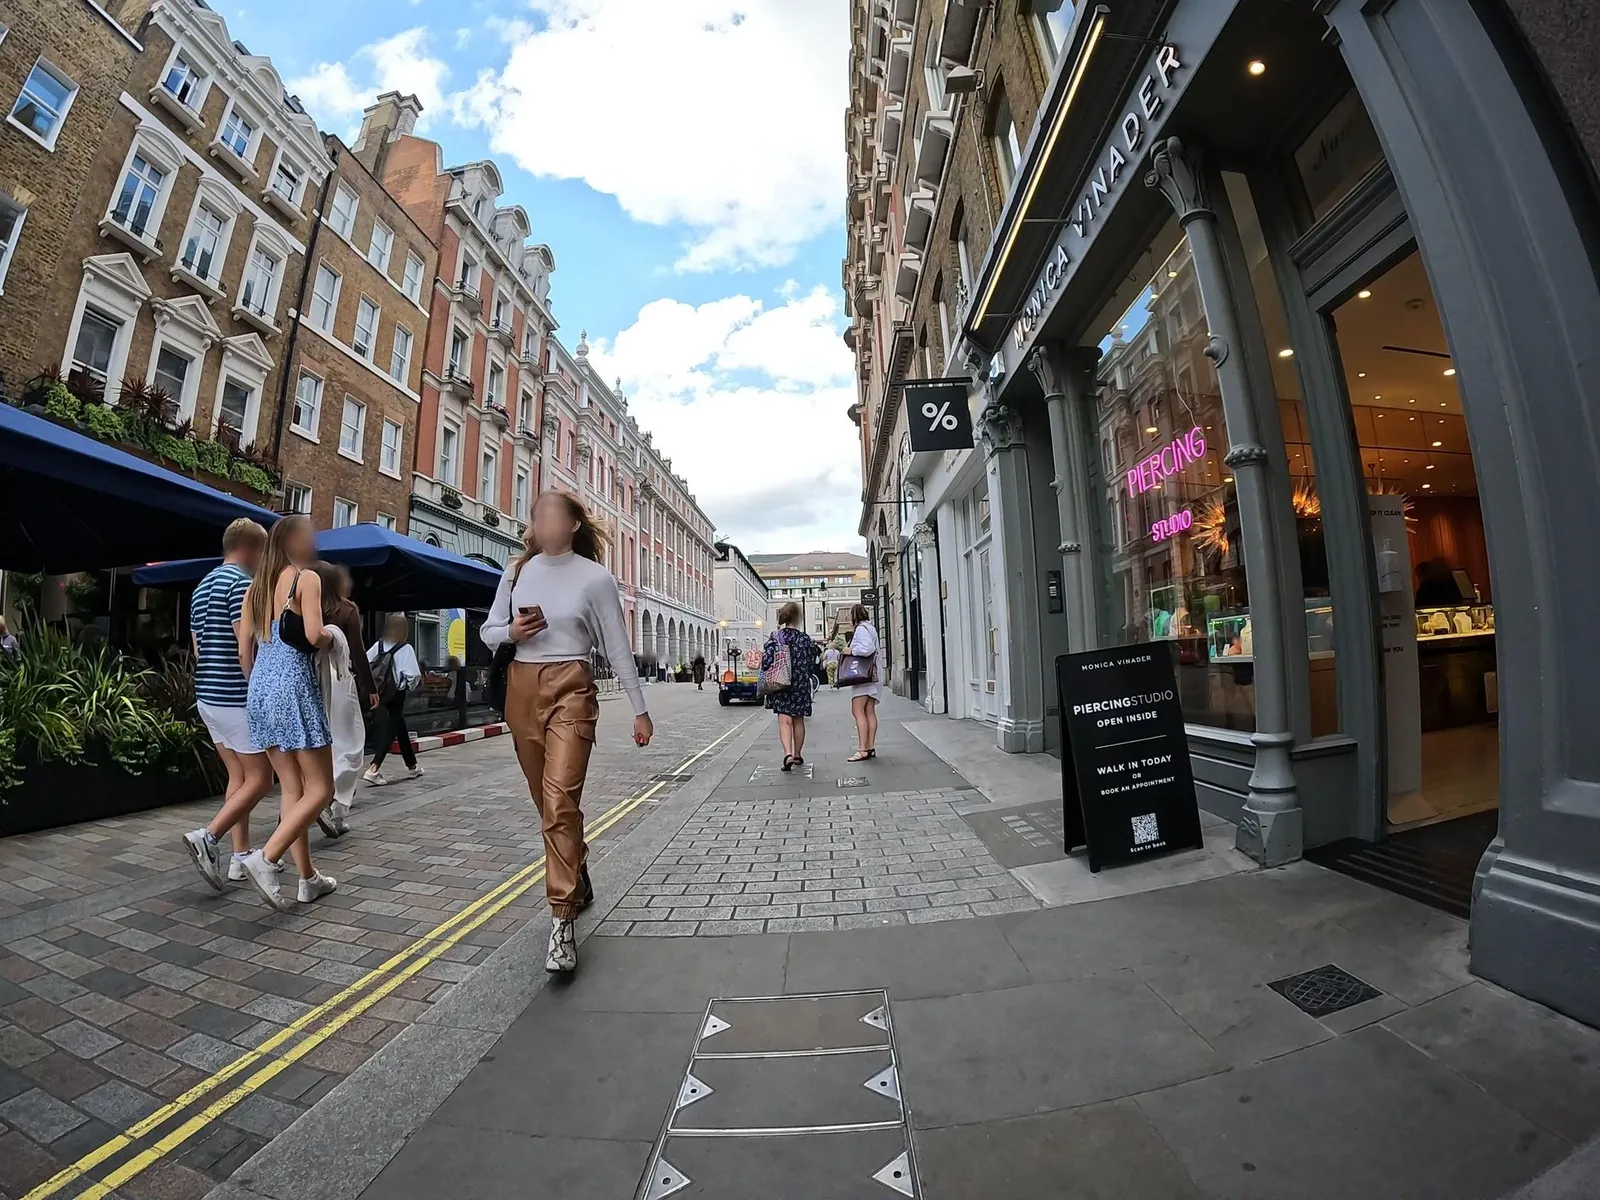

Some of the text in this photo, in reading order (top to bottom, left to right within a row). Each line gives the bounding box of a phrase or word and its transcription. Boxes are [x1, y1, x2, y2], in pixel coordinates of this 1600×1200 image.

[1012, 44, 1181, 350] MONICA VINADER
[1126, 426, 1205, 499] PIERCING
[1151, 509, 1192, 541] STUDIO
[1081, 655, 1151, 671] MONICA VINADER
[1073, 690, 1174, 715] PIERCINGSTUDIO
[1096, 710, 1158, 728] OPEN INSIDE
[1097, 754, 1172, 775] WALK IN TODAY
[1100, 787, 1119, 795] BOOK
[1132, 776, 1175, 790] APPOINTMENT
